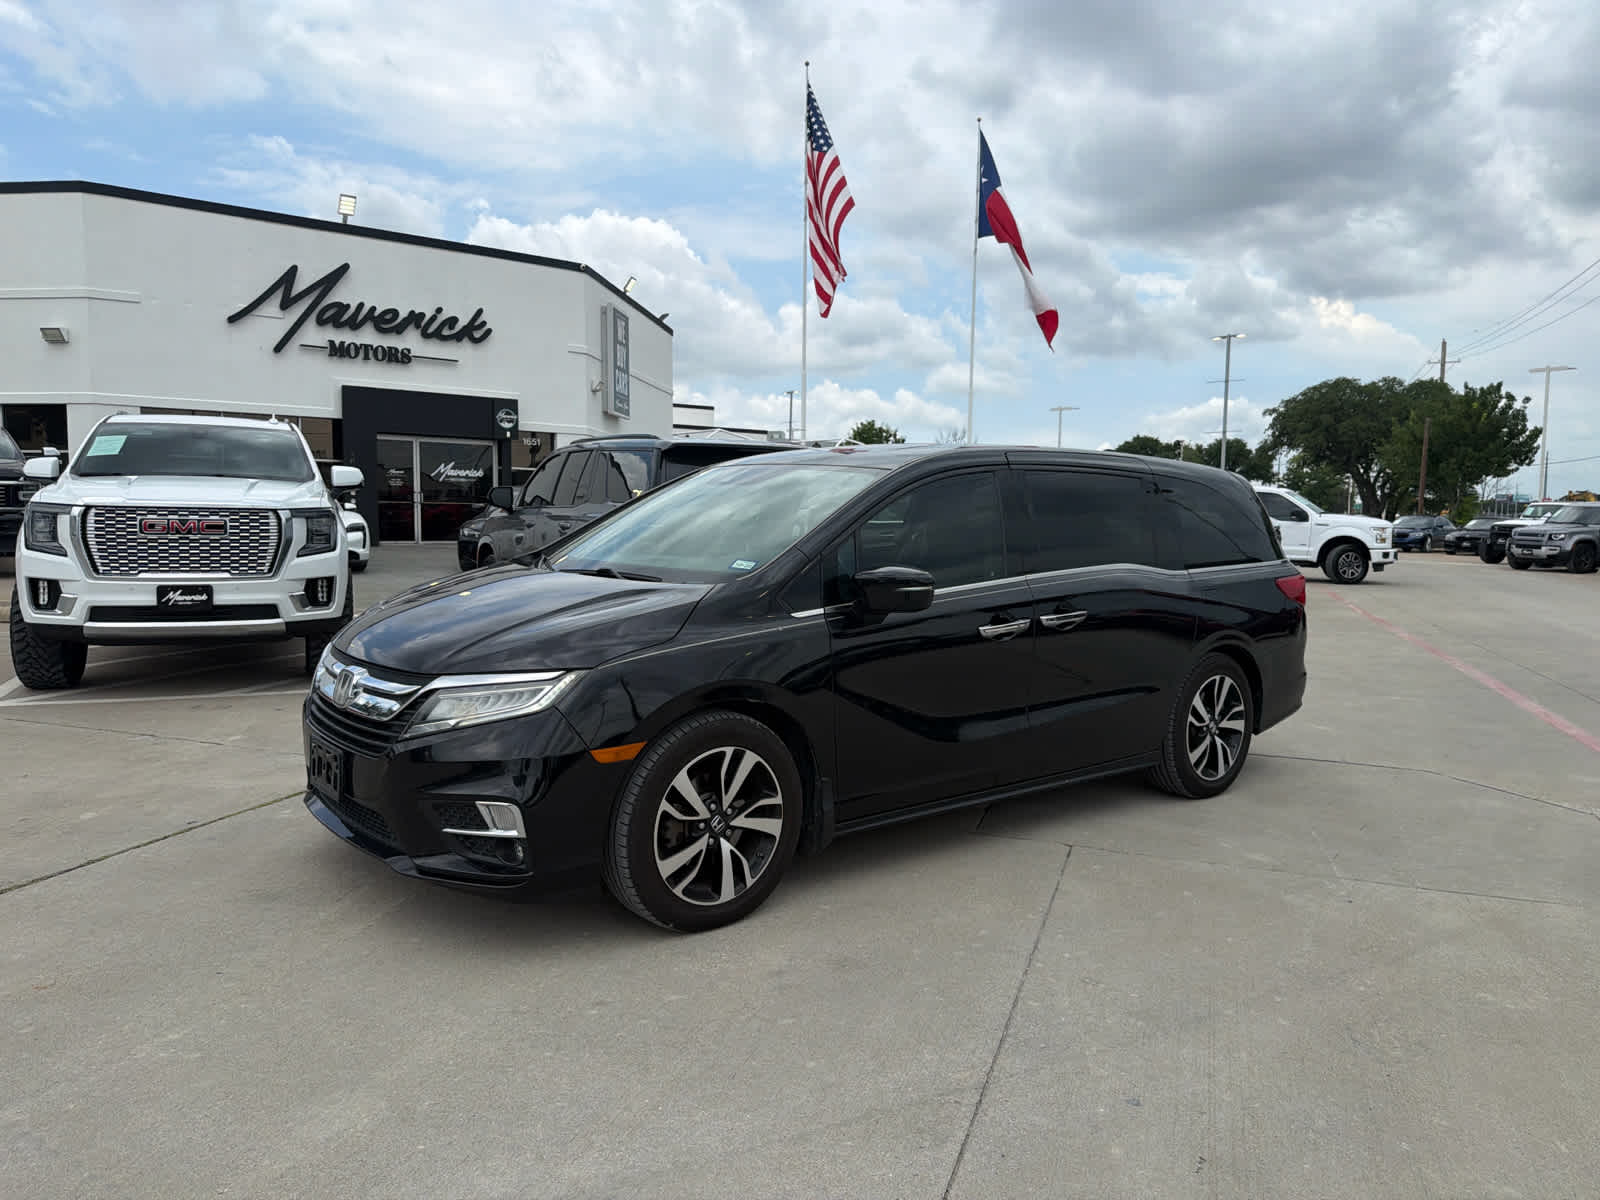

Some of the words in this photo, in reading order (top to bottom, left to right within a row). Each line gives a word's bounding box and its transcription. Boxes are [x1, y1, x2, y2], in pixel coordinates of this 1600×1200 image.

[227, 262, 493, 353] Maverick
[327, 340, 413, 364] MOTORS
[522, 437, 541, 447] 1651
[142, 519, 225, 534] GMC
